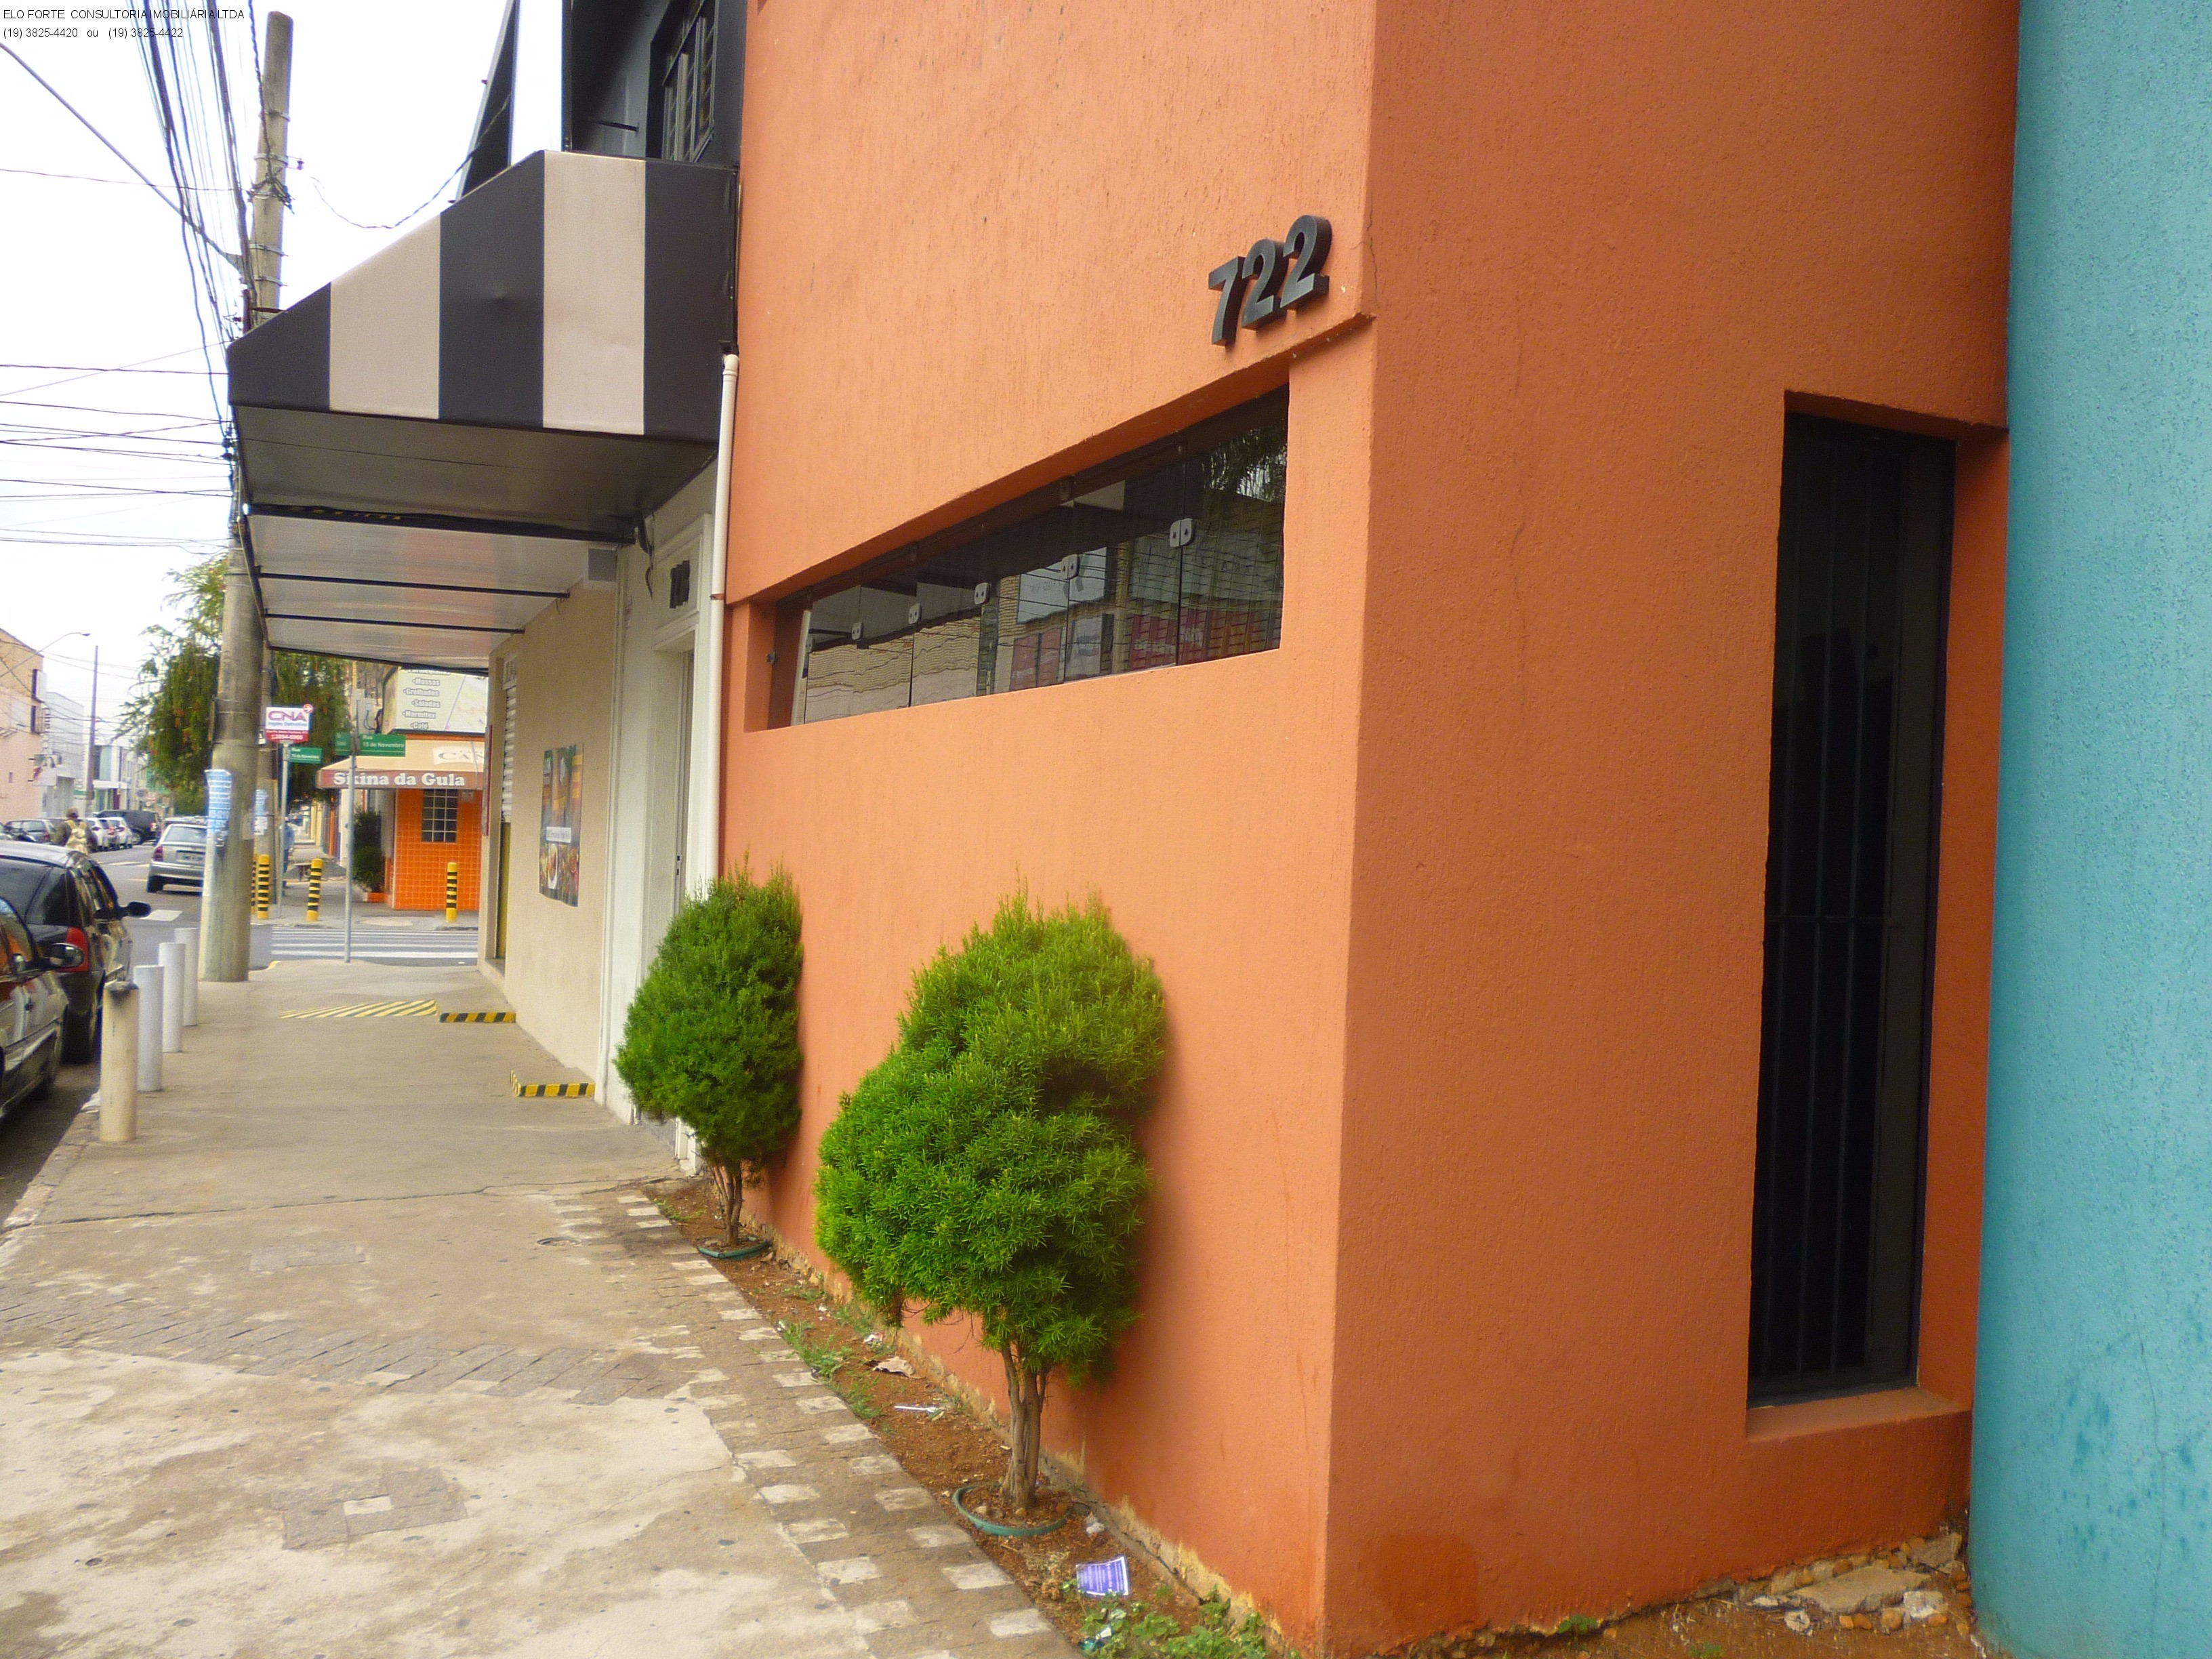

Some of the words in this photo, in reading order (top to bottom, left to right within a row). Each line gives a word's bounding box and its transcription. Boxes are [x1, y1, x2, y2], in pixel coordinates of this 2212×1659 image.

[1208, 215, 1330, 348] 722
[268, 710, 308, 722] CNA
[394, 773, 417, 785] da
[422, 773, 466, 786] Gula
